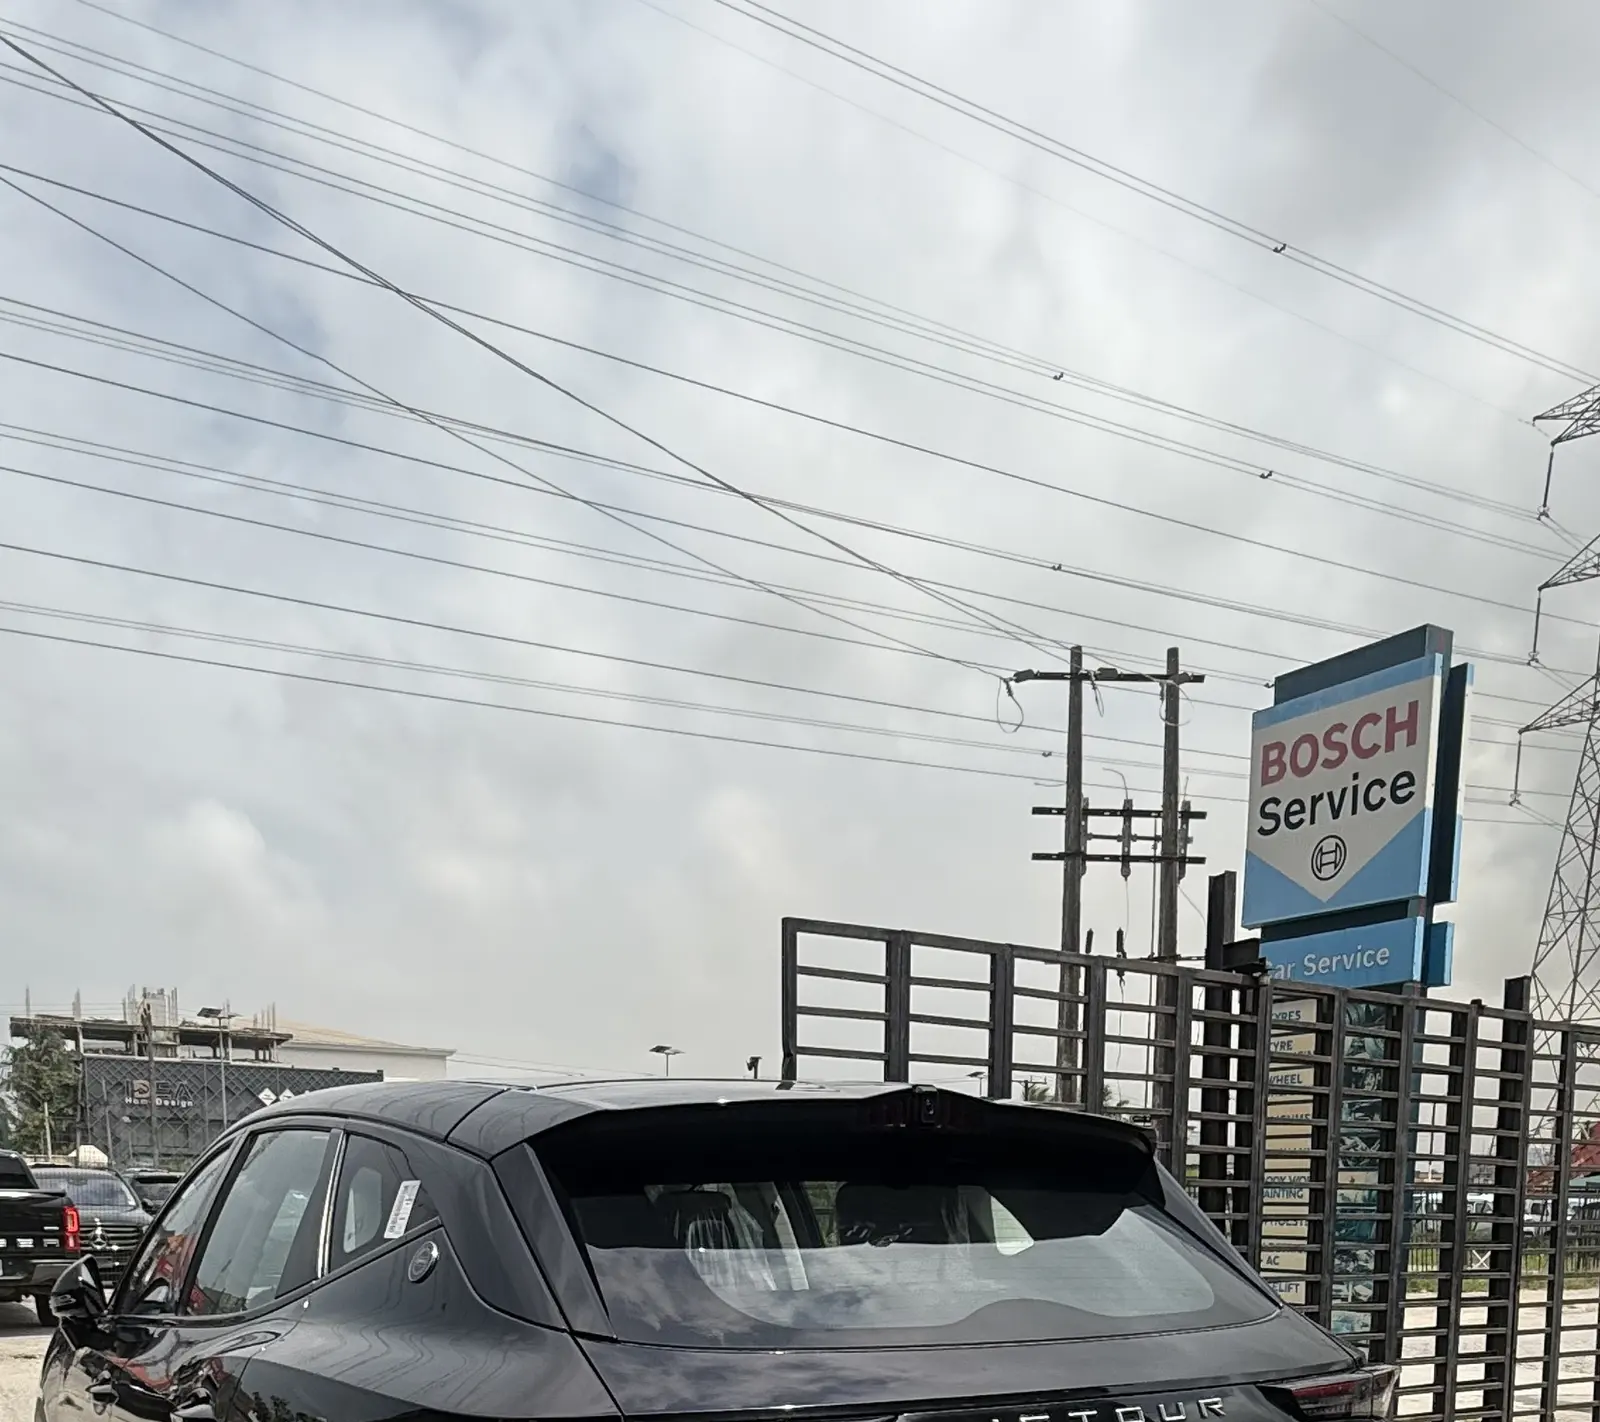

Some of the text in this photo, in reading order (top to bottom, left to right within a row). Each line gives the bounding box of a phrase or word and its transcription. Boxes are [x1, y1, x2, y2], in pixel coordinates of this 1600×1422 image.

[1260, 699, 1419, 787] BOSCH
[1257, 769, 1416, 837] Service
[1303, 944, 1391, 977] Service
[155, 1098, 195, 1109] Design
[1262, 1187, 1304, 1200] AINTING
